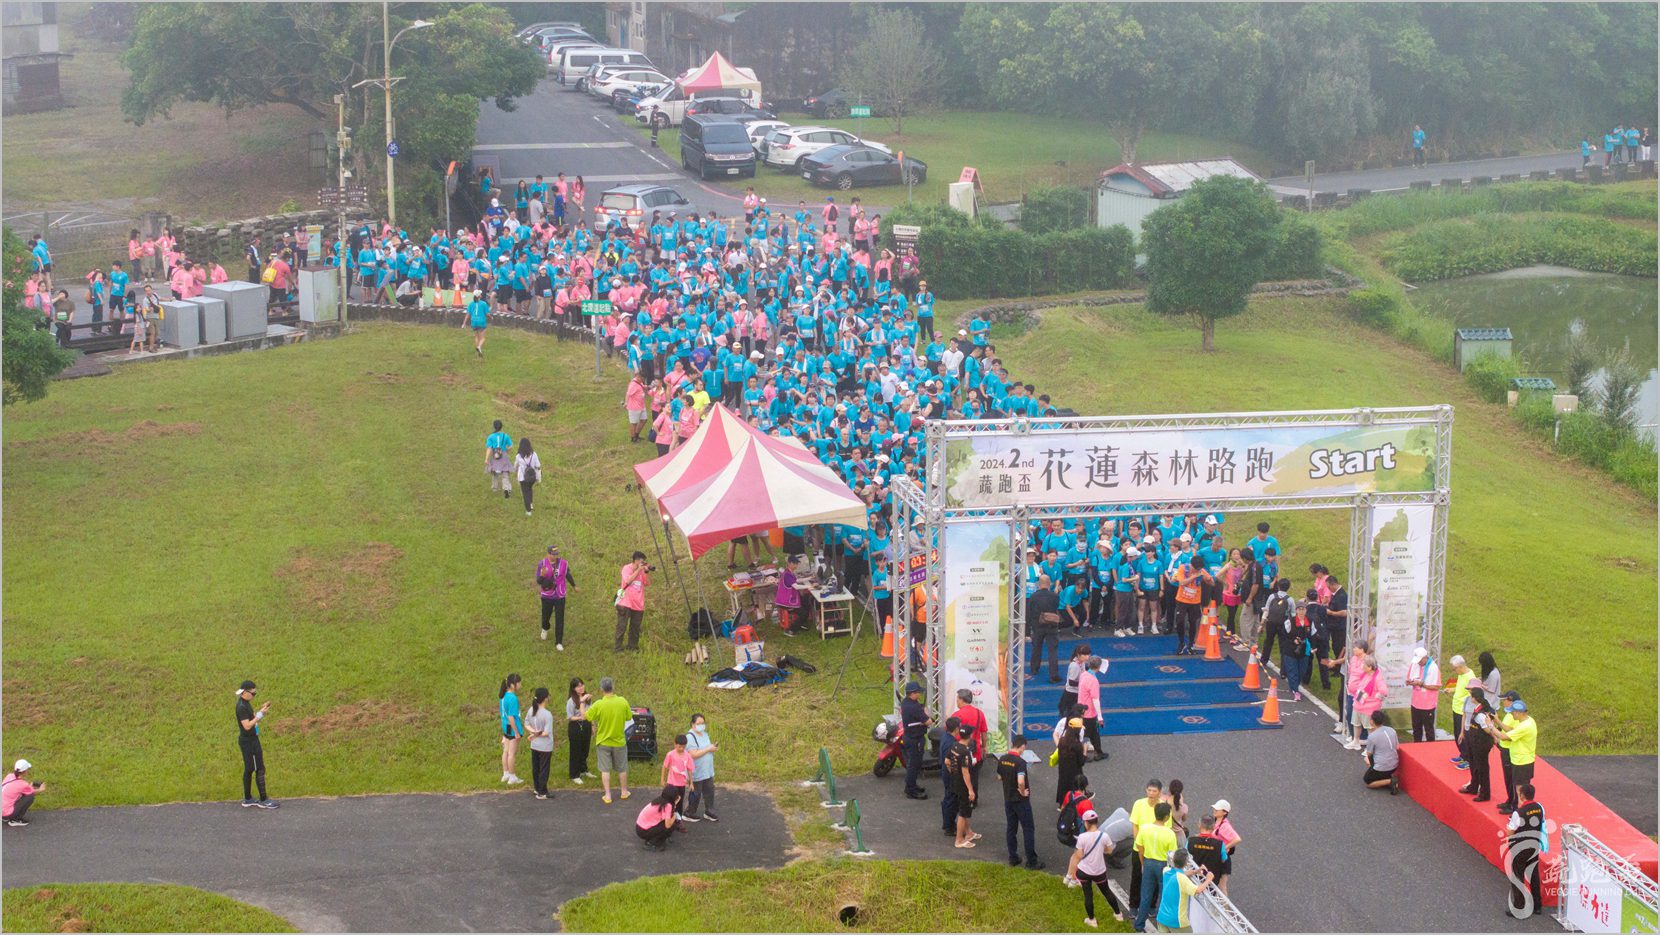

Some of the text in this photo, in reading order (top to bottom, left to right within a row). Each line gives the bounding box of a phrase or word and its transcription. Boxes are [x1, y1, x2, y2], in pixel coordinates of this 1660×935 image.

[1039, 444, 1274, 492] 花蓮森林路跑
[1308, 441, 1397, 479] Start
[979, 474, 1032, 495] 蔬跑盃
